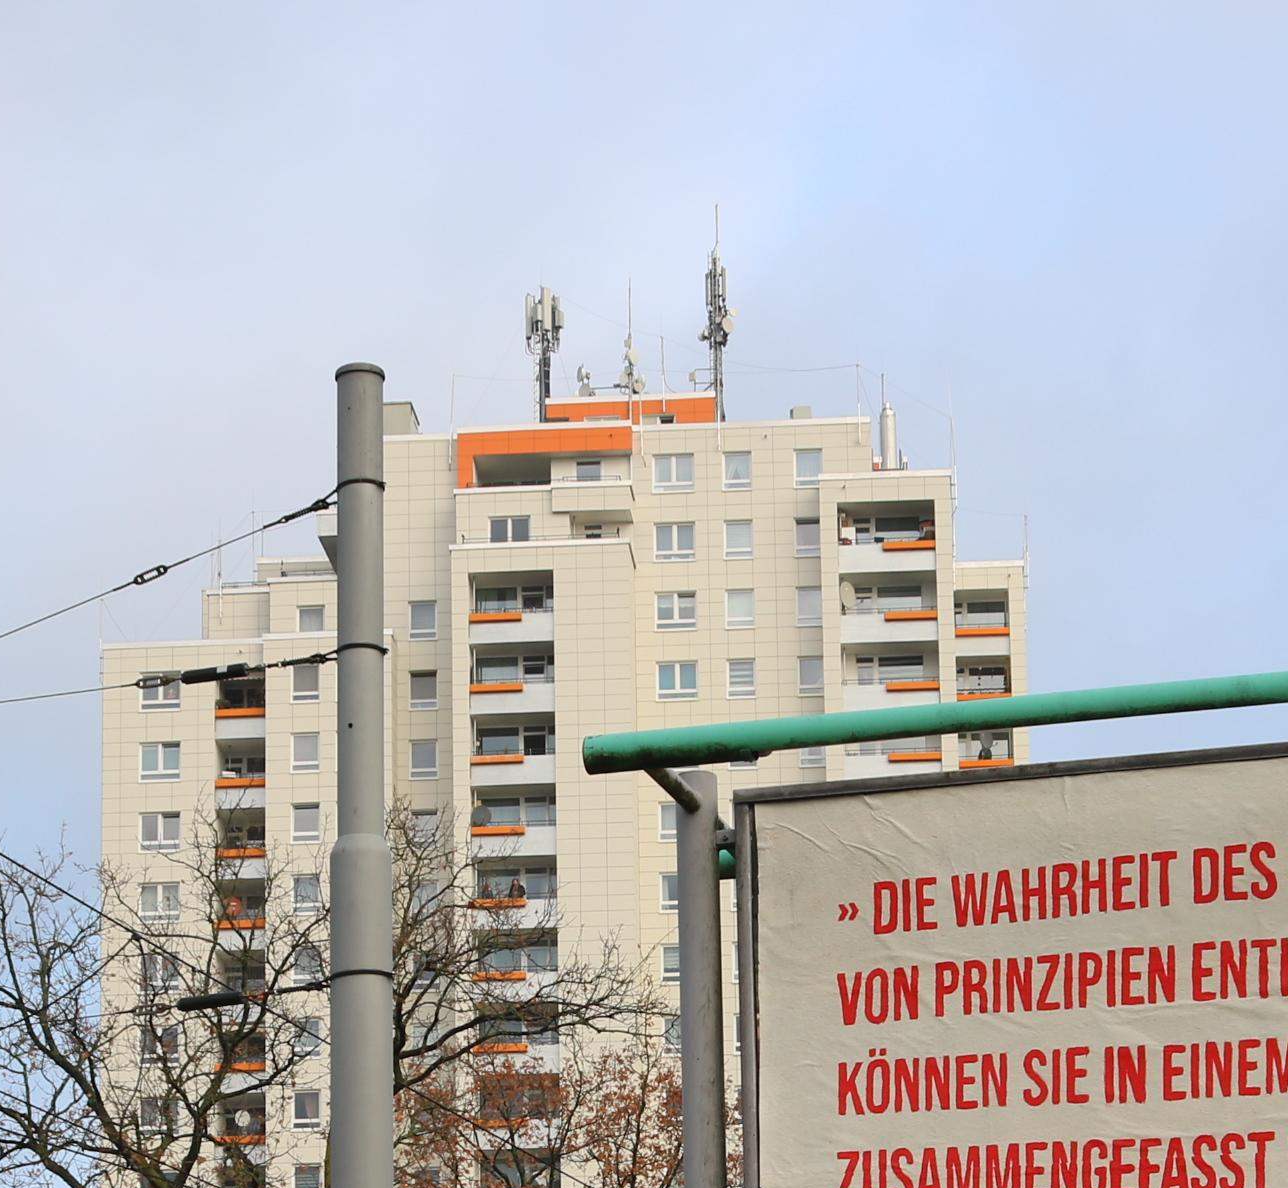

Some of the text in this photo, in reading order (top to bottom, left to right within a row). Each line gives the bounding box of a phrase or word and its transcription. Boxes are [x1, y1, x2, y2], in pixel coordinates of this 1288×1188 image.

[872, 876, 940, 936] DIE
[951, 850, 1179, 928] WAHRHEIT
[1192, 841, 1278, 905] DES
[836, 964, 921, 1026] VON
[934, 945, 1177, 1018] PRINZIPIEN
[837, 1048, 1009, 1116] KÖNNEN
[1022, 1045, 1091, 1108] SIE
[1103, 1044, 1148, 1105] IN
